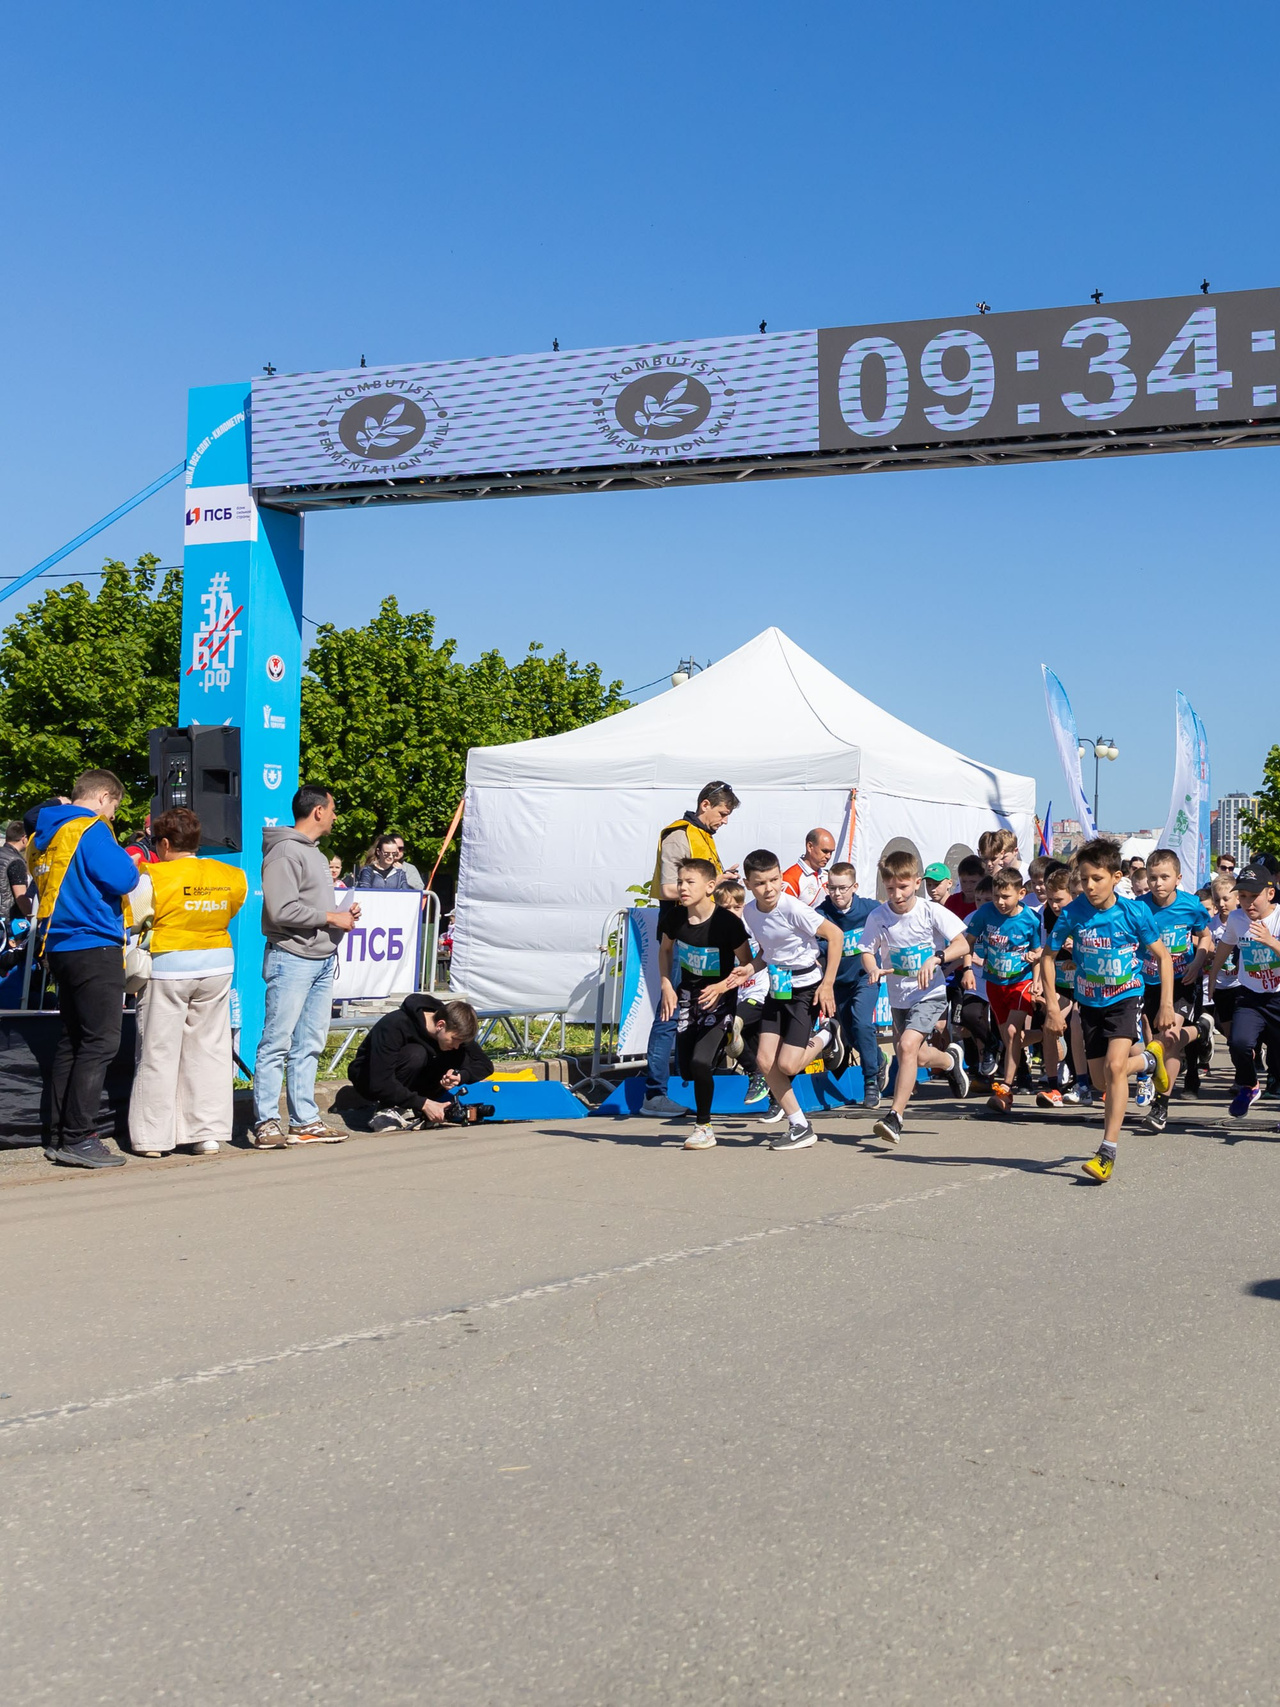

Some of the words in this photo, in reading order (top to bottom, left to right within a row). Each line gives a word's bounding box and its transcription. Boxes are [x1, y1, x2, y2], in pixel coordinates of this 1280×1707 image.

[610, 356, 718, 383] KOMBUTIST
[334, 380, 433, 404] KOMBUTIST
[593, 411, 707, 456] FERMENTATION
[708, 401, 737, 436] SKILL
[318, 431, 422, 474] FERMENTATION
[423, 422, 449, 457] SKILL
[204, 508, 232, 522] ПСБ
[184, 900, 228, 912] СУДЬЯ
[346, 927, 404, 962] ПСБ
[687, 952, 707, 970] 297
[901, 953, 921, 970] 267
[1251, 948, 1272, 964] 282
[994, 959, 1012, 972] 279
[1097, 958, 1122, 976] 249
